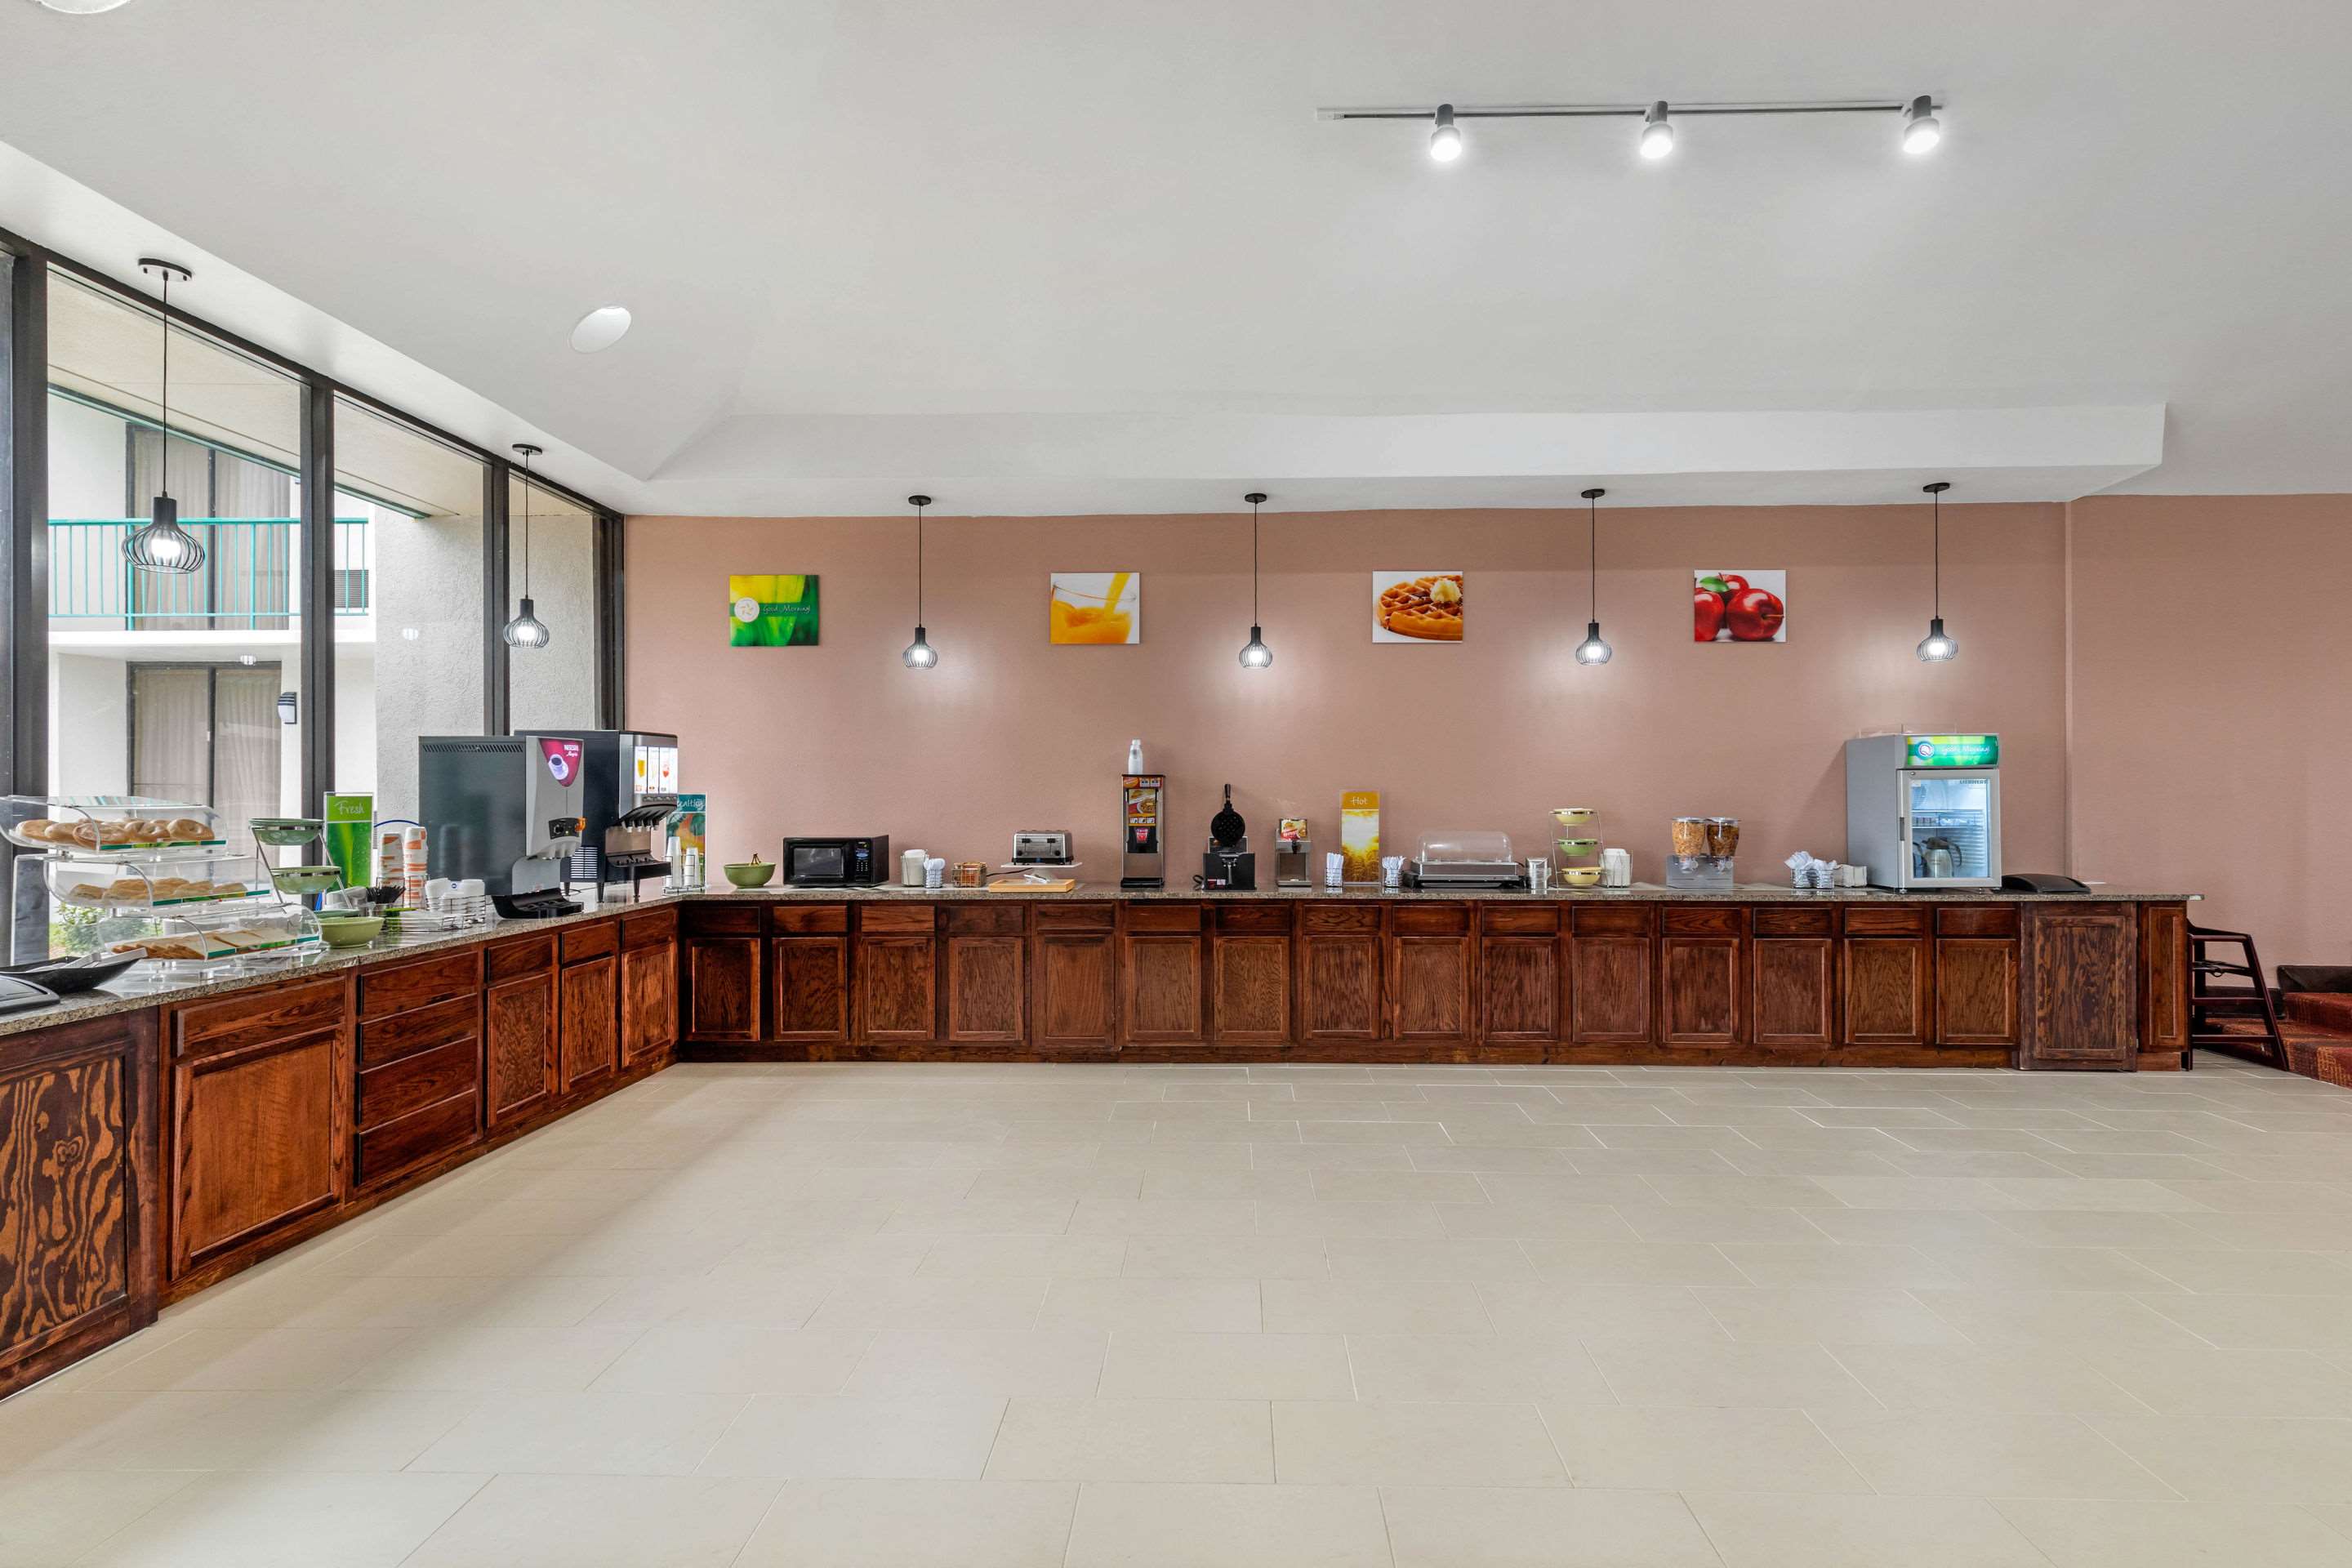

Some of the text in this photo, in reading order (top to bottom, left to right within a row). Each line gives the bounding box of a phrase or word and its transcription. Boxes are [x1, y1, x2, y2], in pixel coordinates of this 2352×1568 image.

[763, 604, 778, 614] Good
[677, 798, 705, 810] ealthy
[1350, 796, 1369, 805] Hot
[333, 800, 366, 815] Fresh
